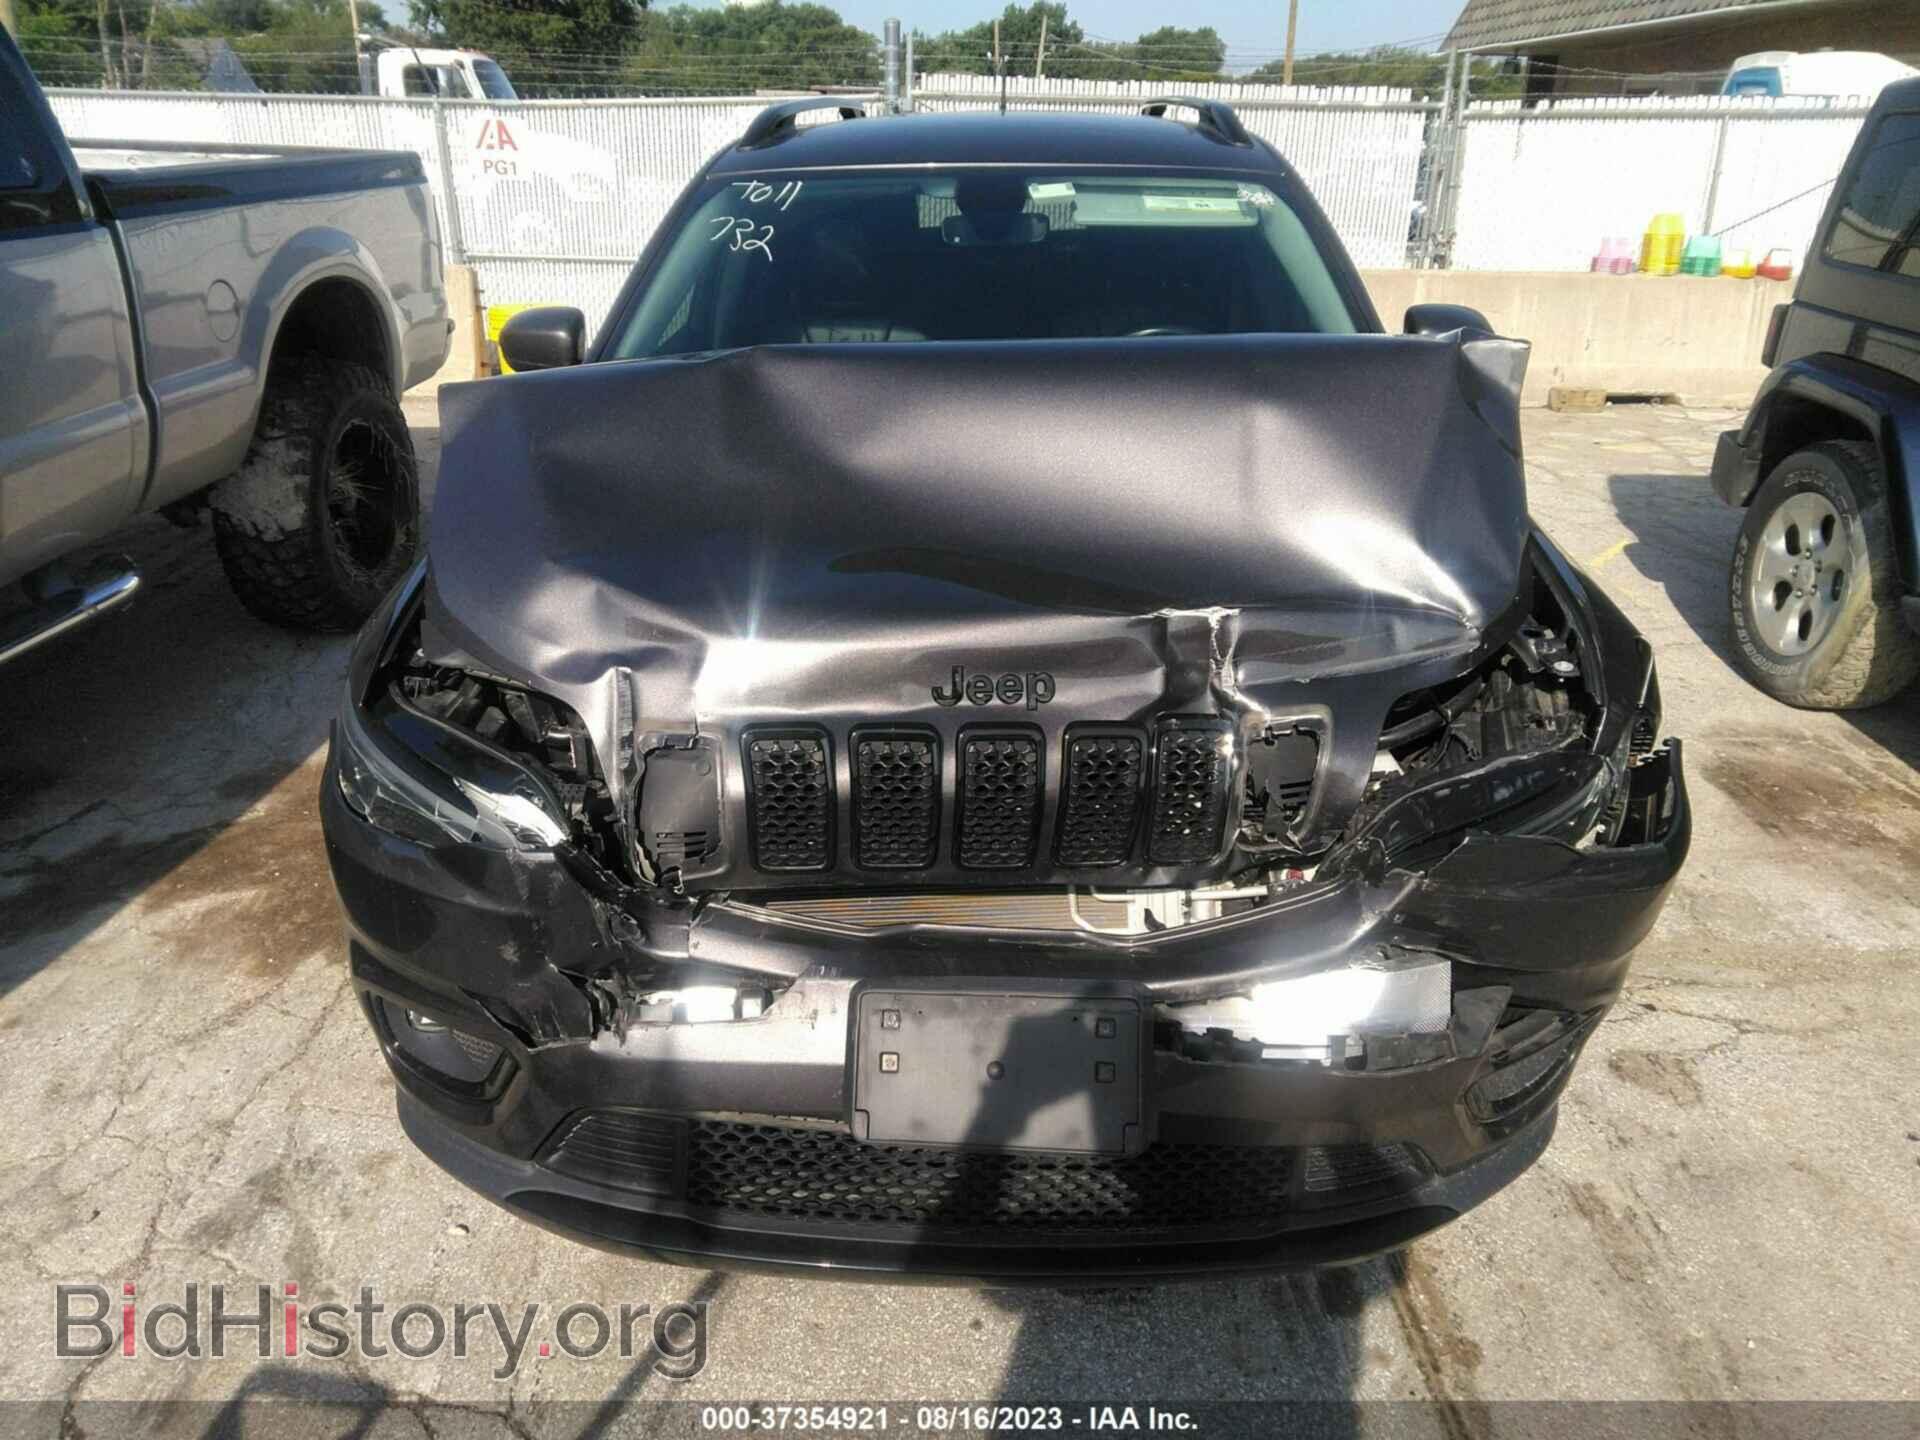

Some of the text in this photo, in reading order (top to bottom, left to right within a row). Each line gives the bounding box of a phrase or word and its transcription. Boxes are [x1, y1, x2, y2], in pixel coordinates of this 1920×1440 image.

[483, 159, 517, 176] PG1
[709, 216, 774, 262] 732
[931, 664, 1056, 712] Jeep
